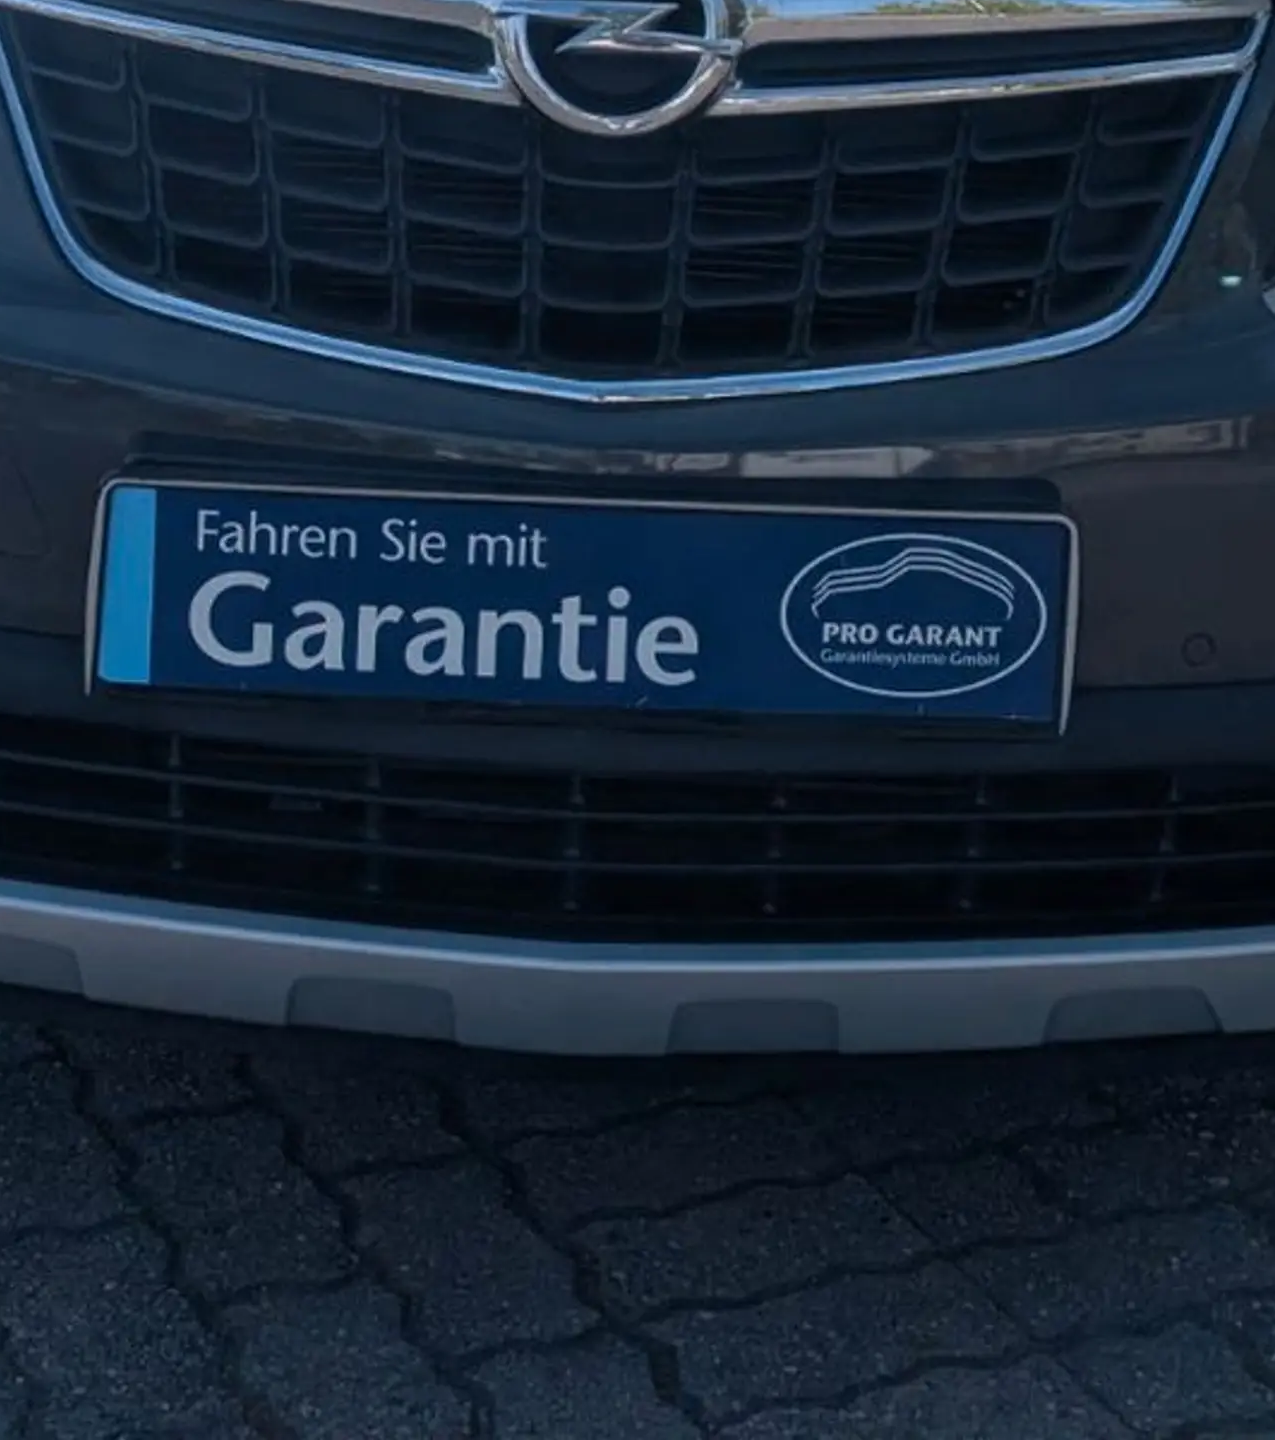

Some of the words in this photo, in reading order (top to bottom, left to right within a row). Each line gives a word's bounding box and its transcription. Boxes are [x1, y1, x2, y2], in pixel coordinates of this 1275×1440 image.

[195, 508, 358, 559] Fahren
[380, 516, 448, 564] Sie
[467, 522, 549, 570] mit
[188, 570, 700, 685] Garantie
[822, 621, 879, 644] PRO
[886, 623, 1003, 648] GARANT
[820, 647, 947, 669] Garantiesysteme
[949, 650, 1000, 667] GmbH
